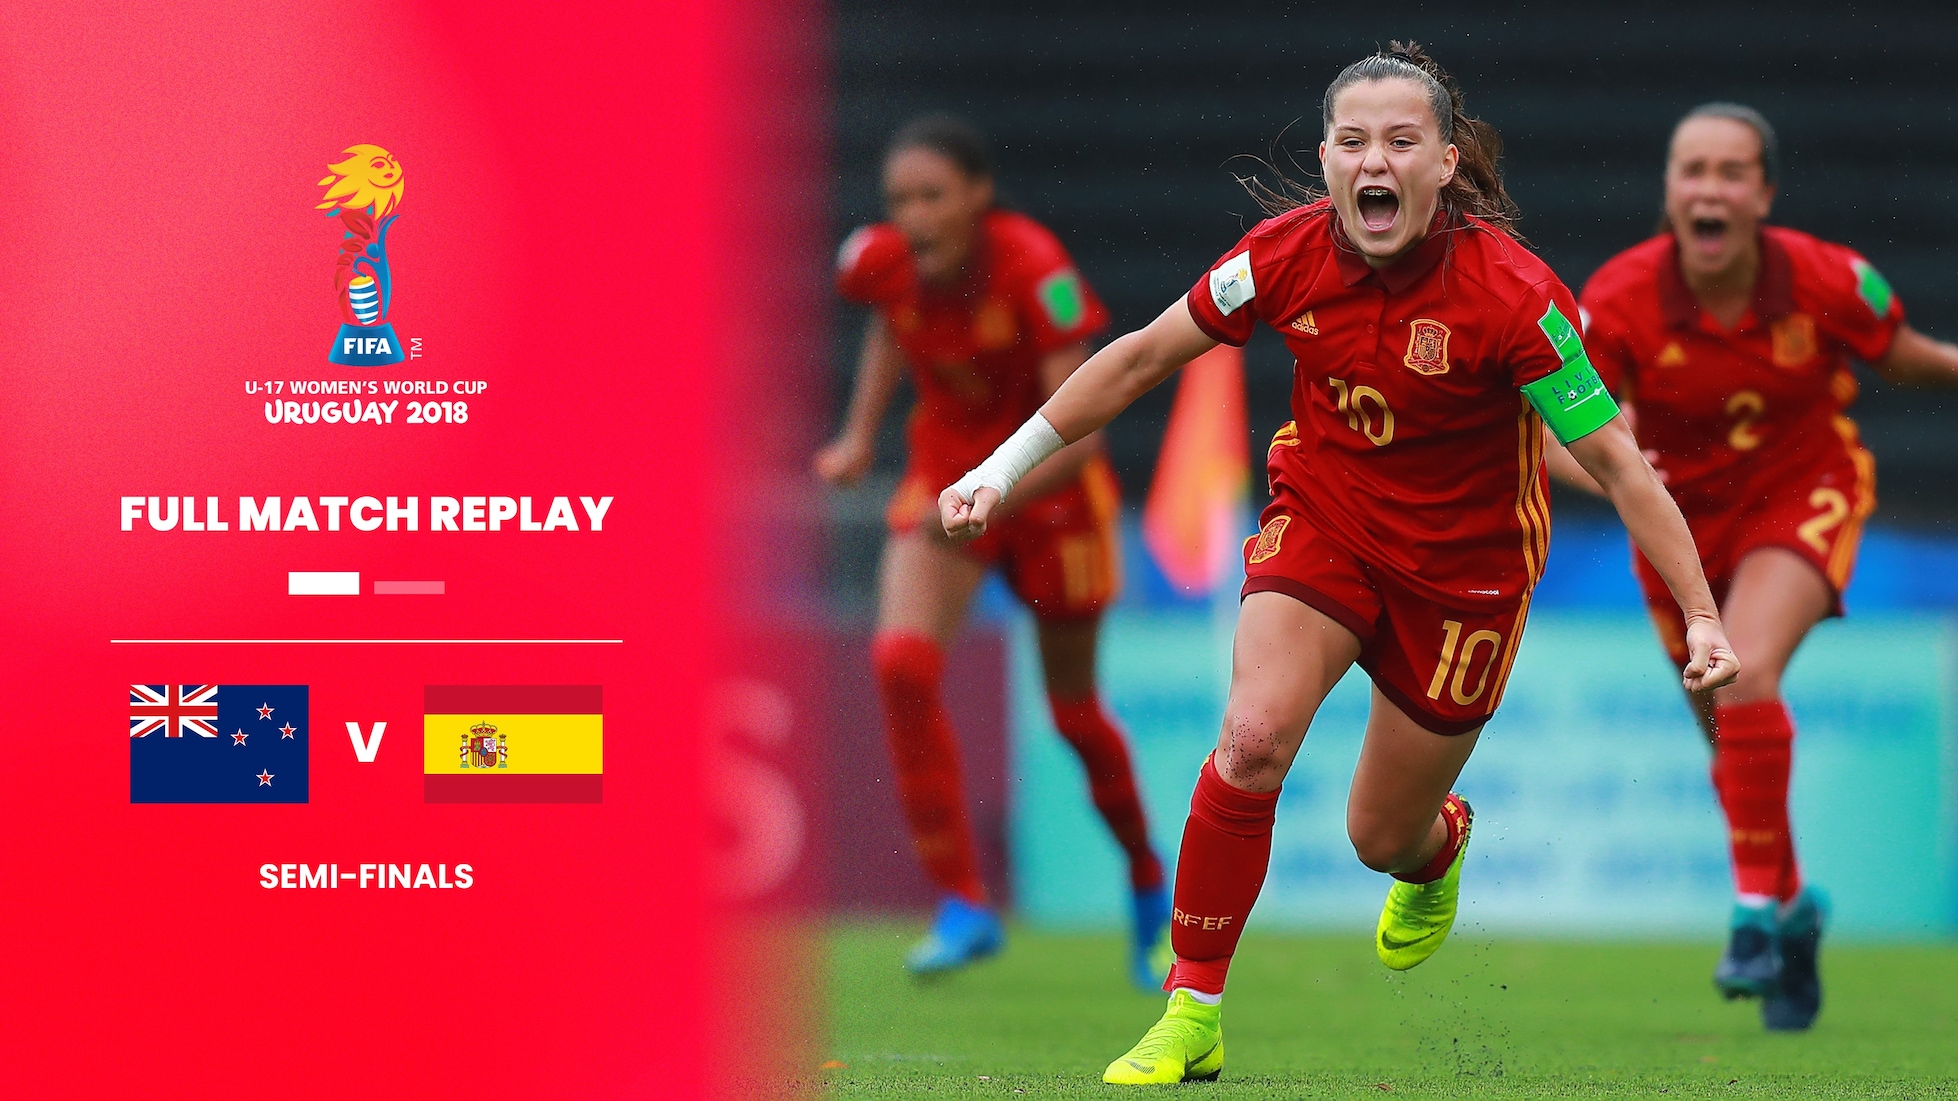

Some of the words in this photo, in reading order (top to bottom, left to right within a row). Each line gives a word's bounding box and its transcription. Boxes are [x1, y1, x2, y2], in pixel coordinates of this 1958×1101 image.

[1292, 321, 1319, 336] adidas
[1328, 376, 1395, 446] 10
[1725, 389, 1764, 450] 2
[1797, 486, 1848, 556] 2
[1427, 620, 1501, 706] 10
[1173, 907, 1233, 931] RFEF
